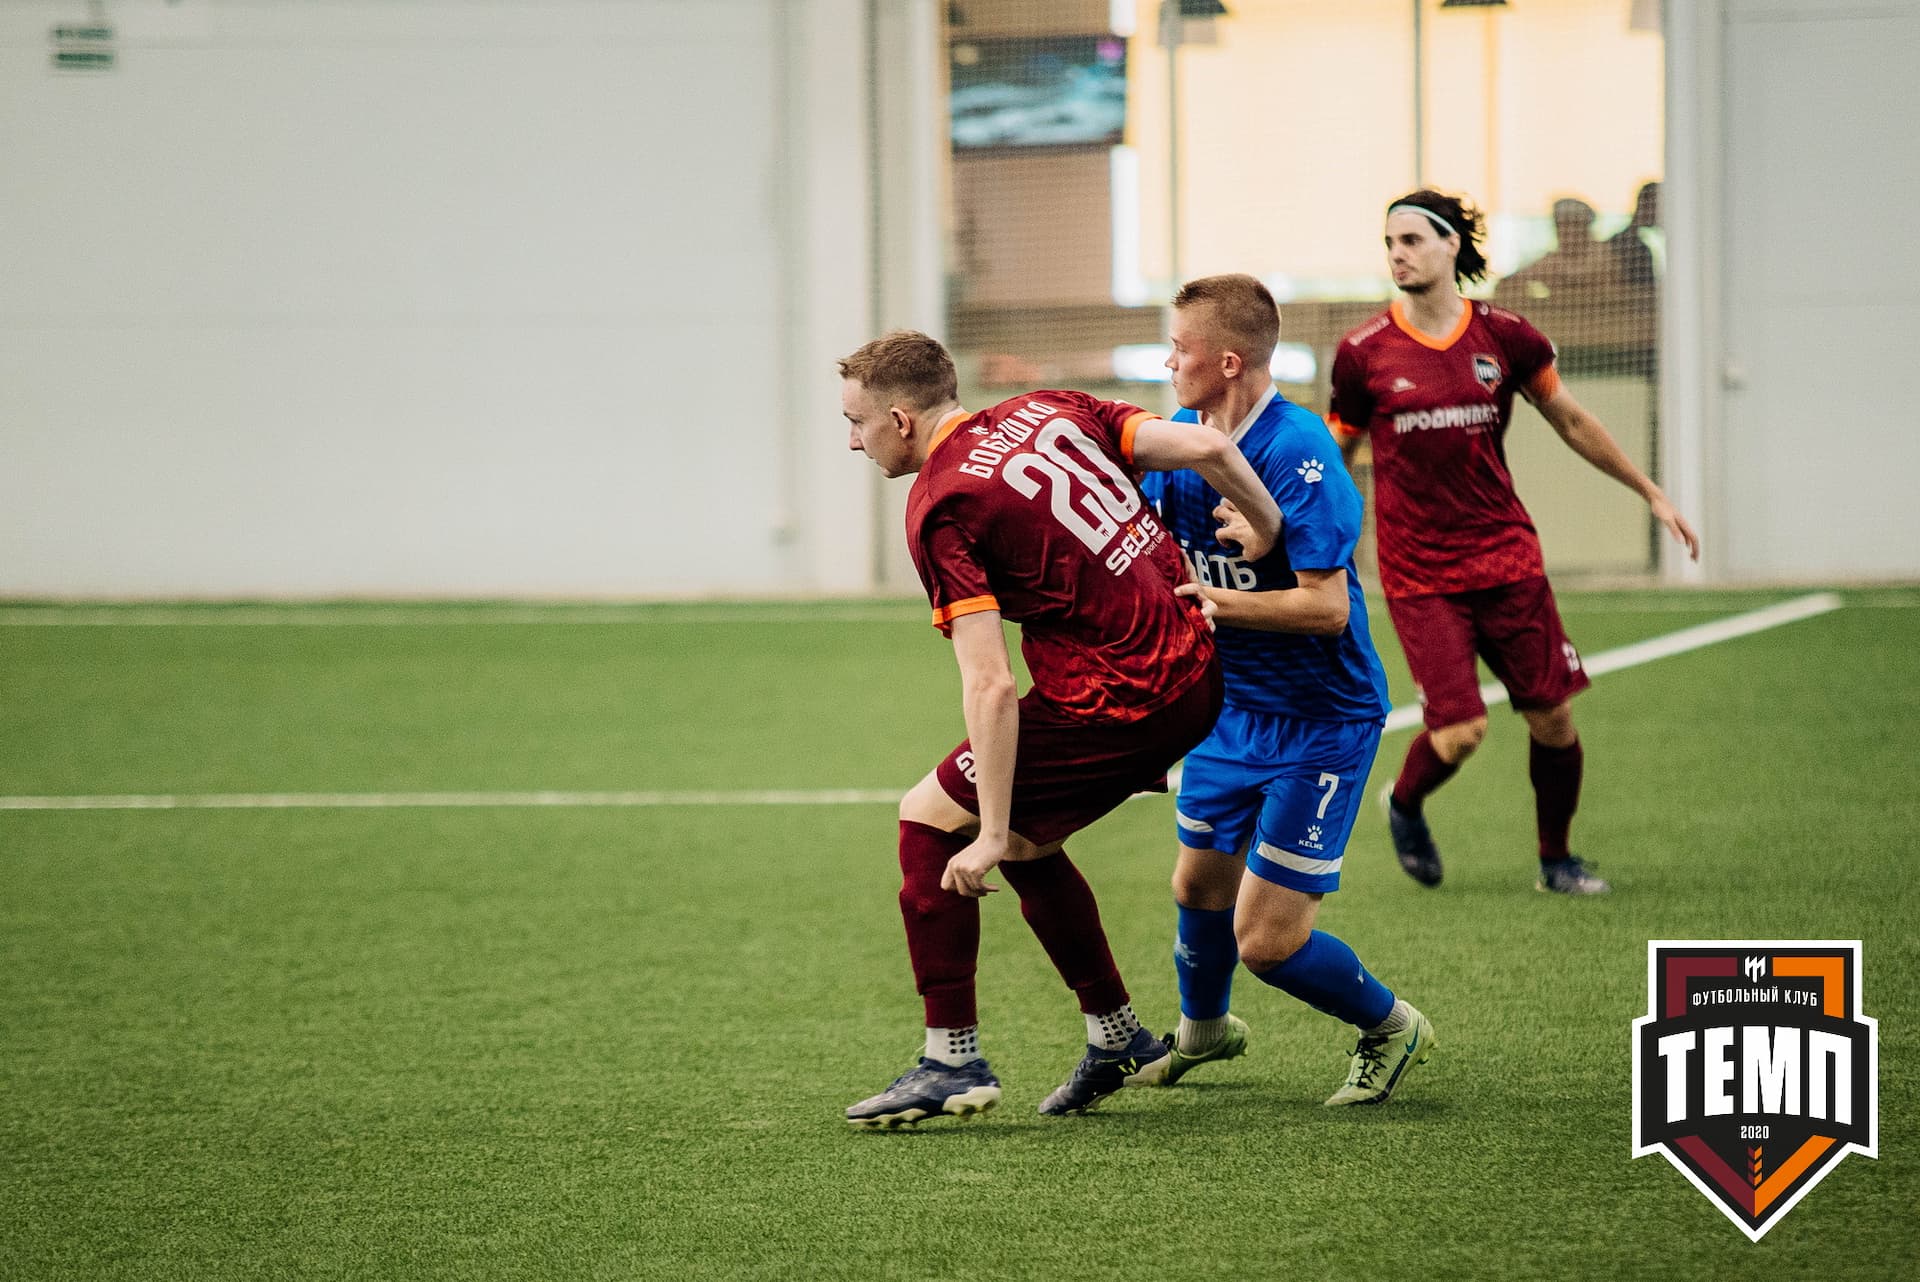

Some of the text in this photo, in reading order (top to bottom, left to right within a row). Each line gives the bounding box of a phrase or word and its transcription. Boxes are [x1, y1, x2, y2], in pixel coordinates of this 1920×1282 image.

[1002, 417, 1141, 556] 20
[1318, 772, 1340, 820] 7
[1298, 839, 1324, 851] KELME
